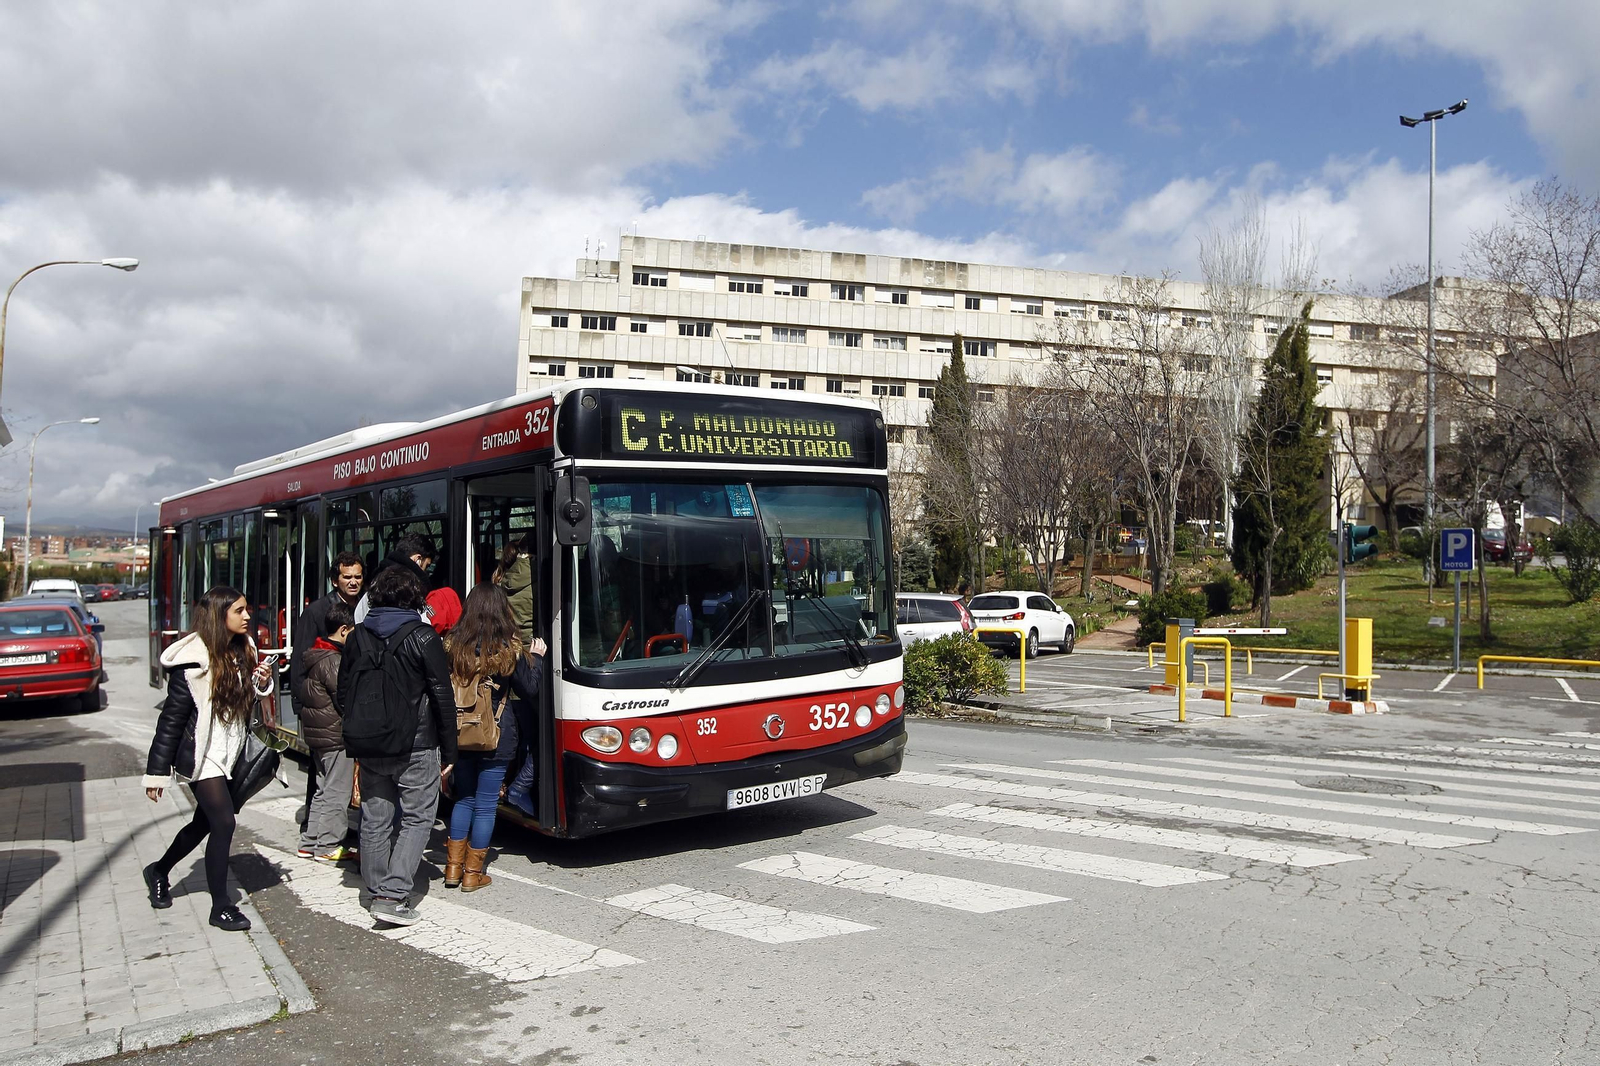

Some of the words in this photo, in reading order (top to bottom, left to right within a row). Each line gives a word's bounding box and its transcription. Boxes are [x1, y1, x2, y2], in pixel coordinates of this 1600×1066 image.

[482, 428, 520, 450] ENTRADA
[524, 406, 550, 436] 352
[621, 408, 648, 450] C
[659, 410, 682, 429] P.
[693, 413, 836, 437] MALDONADO
[333, 461, 350, 480] PISO
[354, 454, 376, 476] BAJO
[380, 441, 429, 469] CONTINUO
[287, 481, 301, 492] SALIDA
[1447, 533, 1467, 557] P
[602, 698, 670, 711] Castrosua
[809, 702, 850, 731] 352
[697, 717, 717, 736] 352
[736, 786, 769, 805] 9608
[773, 781, 796, 799] CVV
